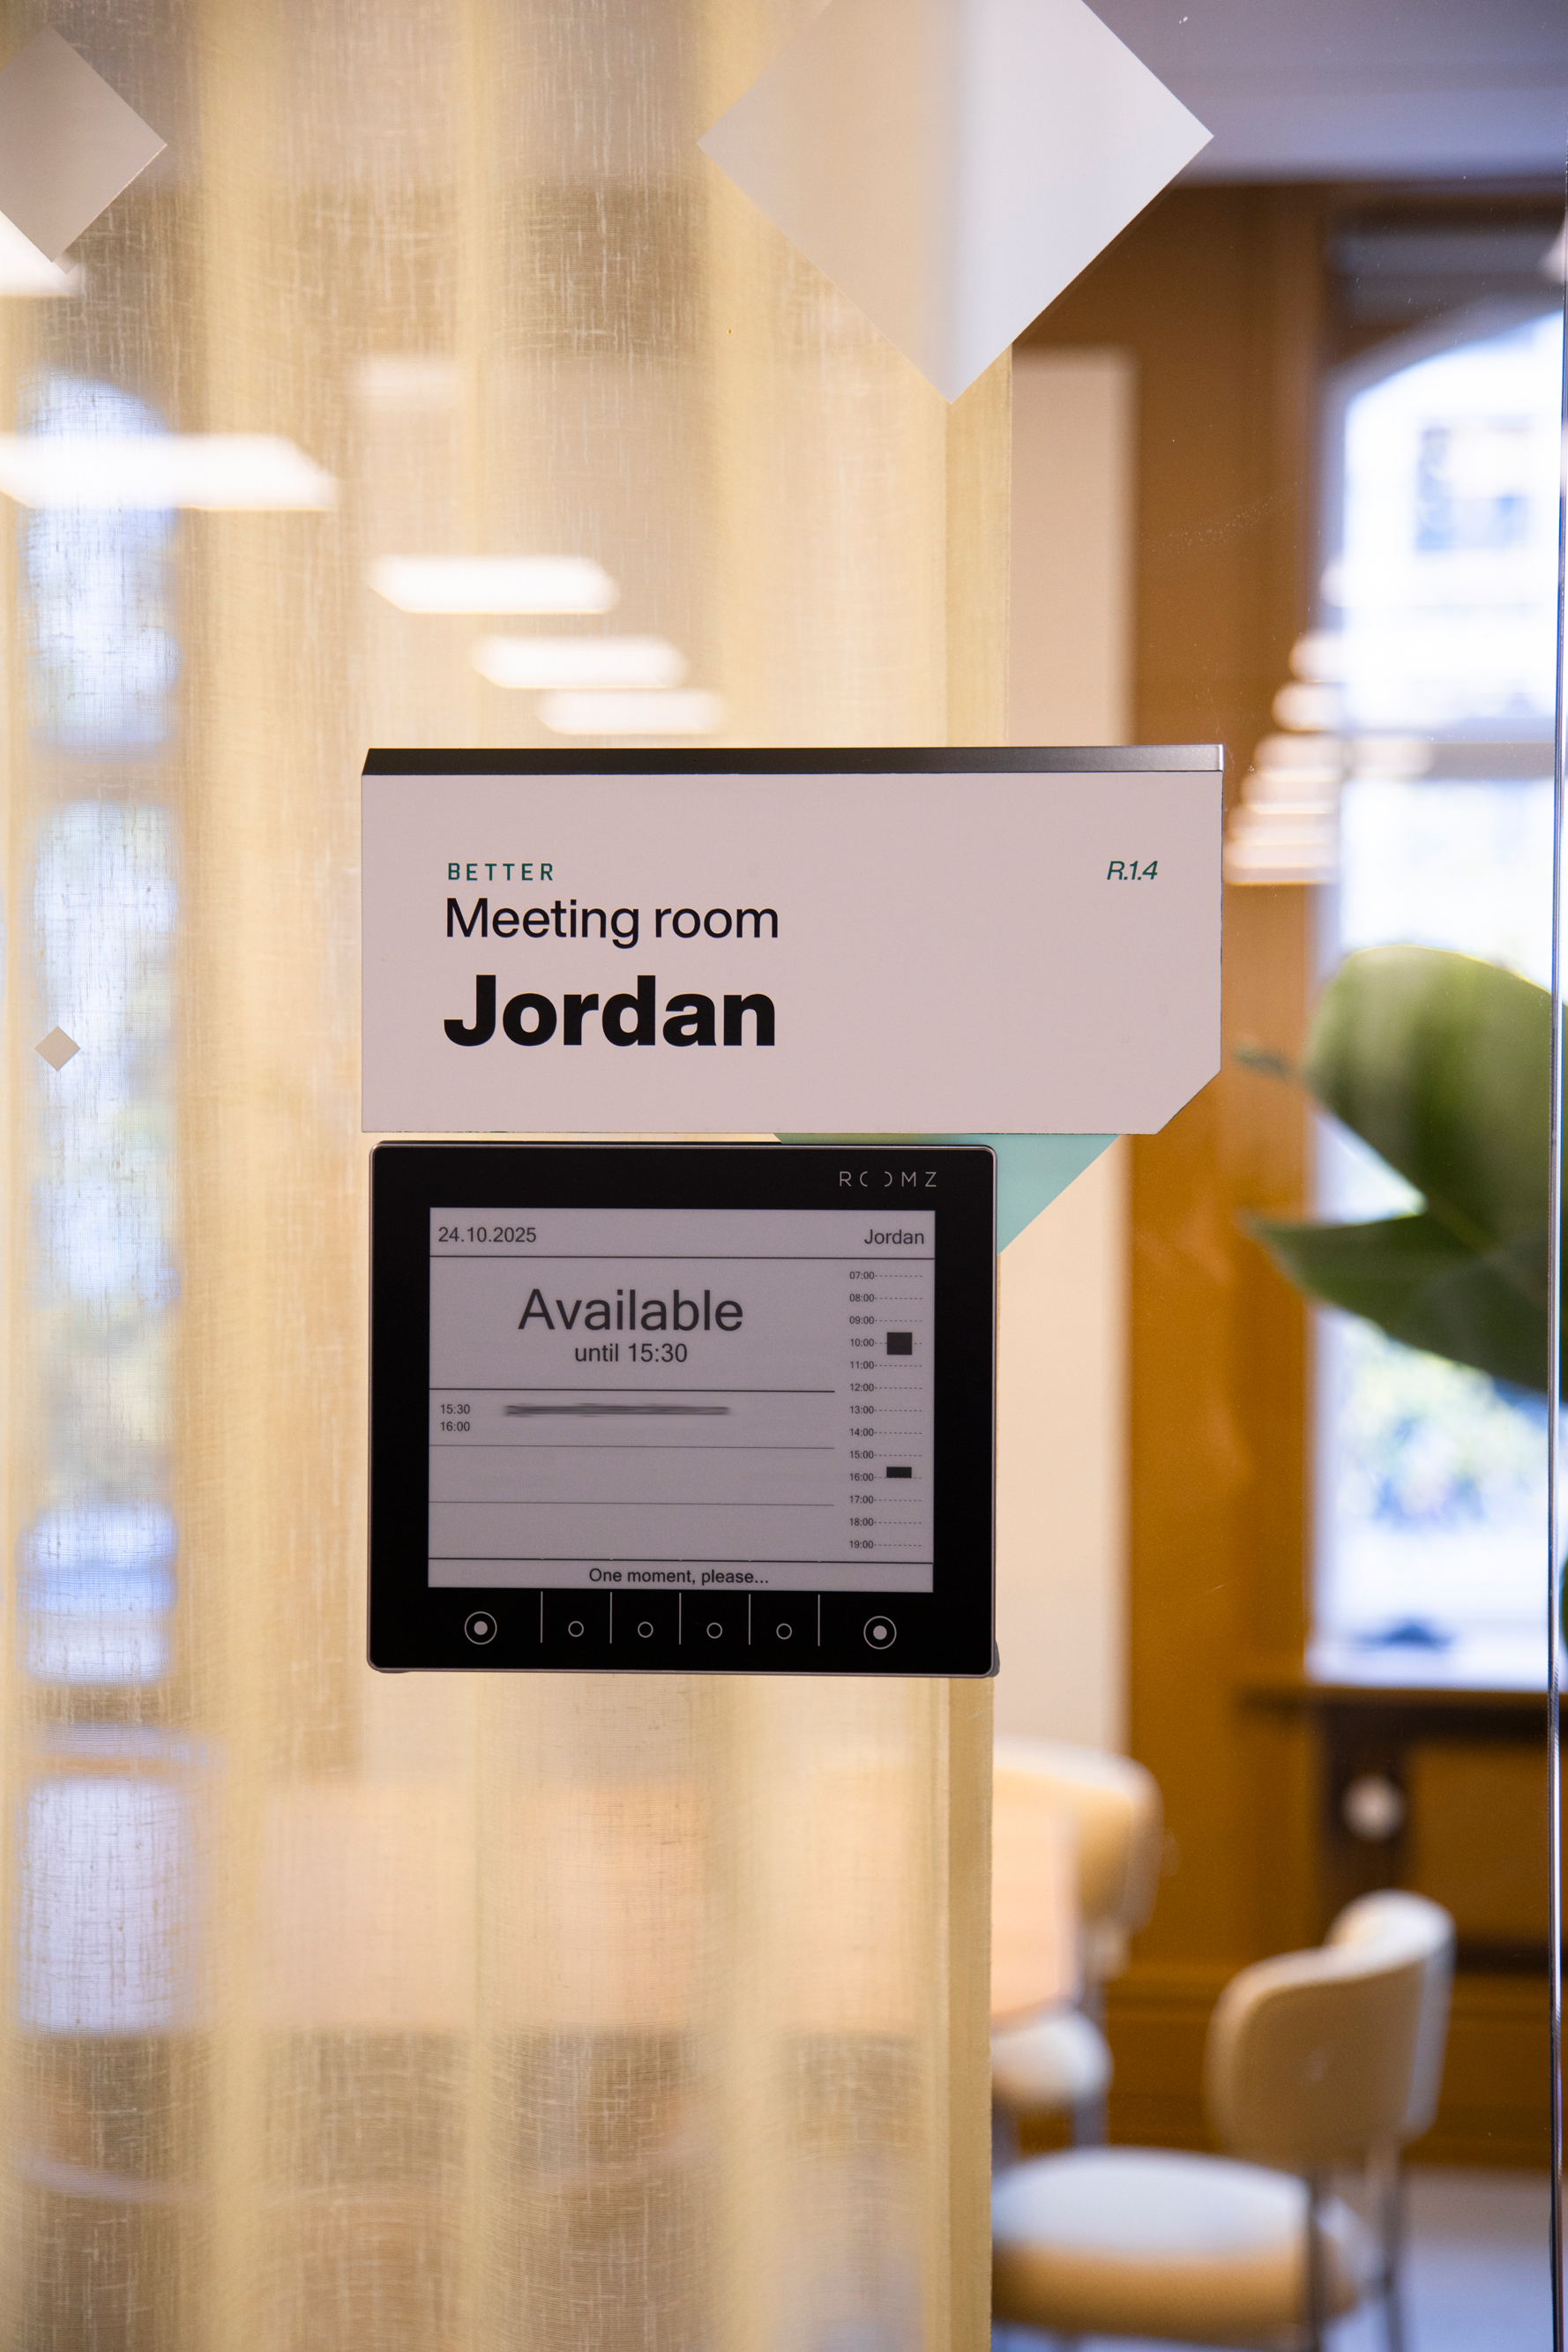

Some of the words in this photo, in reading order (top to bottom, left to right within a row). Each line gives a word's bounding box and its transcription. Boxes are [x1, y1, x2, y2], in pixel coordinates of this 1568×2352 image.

[448, 862, 553, 881] BETTER
[1106, 860, 1159, 881] R.1.4
[446, 897, 639, 950] Meeting
[654, 907, 779, 939] room
[444, 974, 775, 1048] Jordan
[437, 1226, 537, 1243] 24.10.2025
[863, 1228, 924, 1245] Jordan
[849, 1271, 875, 1280] 07:00
[849, 1293, 875, 1303] 08:00
[518, 1288, 743, 1332] Available
[849, 1316, 875, 1325] 09:00
[850, 1338, 875, 1348] 10:00
[574, 1342, 619, 1363] until
[628, 1342, 688, 1363] 15:30
[850, 1360, 875, 1370] 11:00
[849, 1383, 875, 1393] 12:00
[440, 1403, 471, 1415] 15:30
[850, 1405, 875, 1415] 13:00
[440, 1421, 471, 1432] 16:00
[849, 1428, 875, 1437] 14:00
[849, 1450, 875, 1460] 15:00
[849, 1472, 874, 1482] 16:00
[849, 1495, 874, 1505] 17:00
[849, 1517, 874, 1527] 18:00
[849, 1540, 874, 1549] 19:00
[588, 1567, 623, 1582] One
[627, 1570, 696, 1585] moment,
